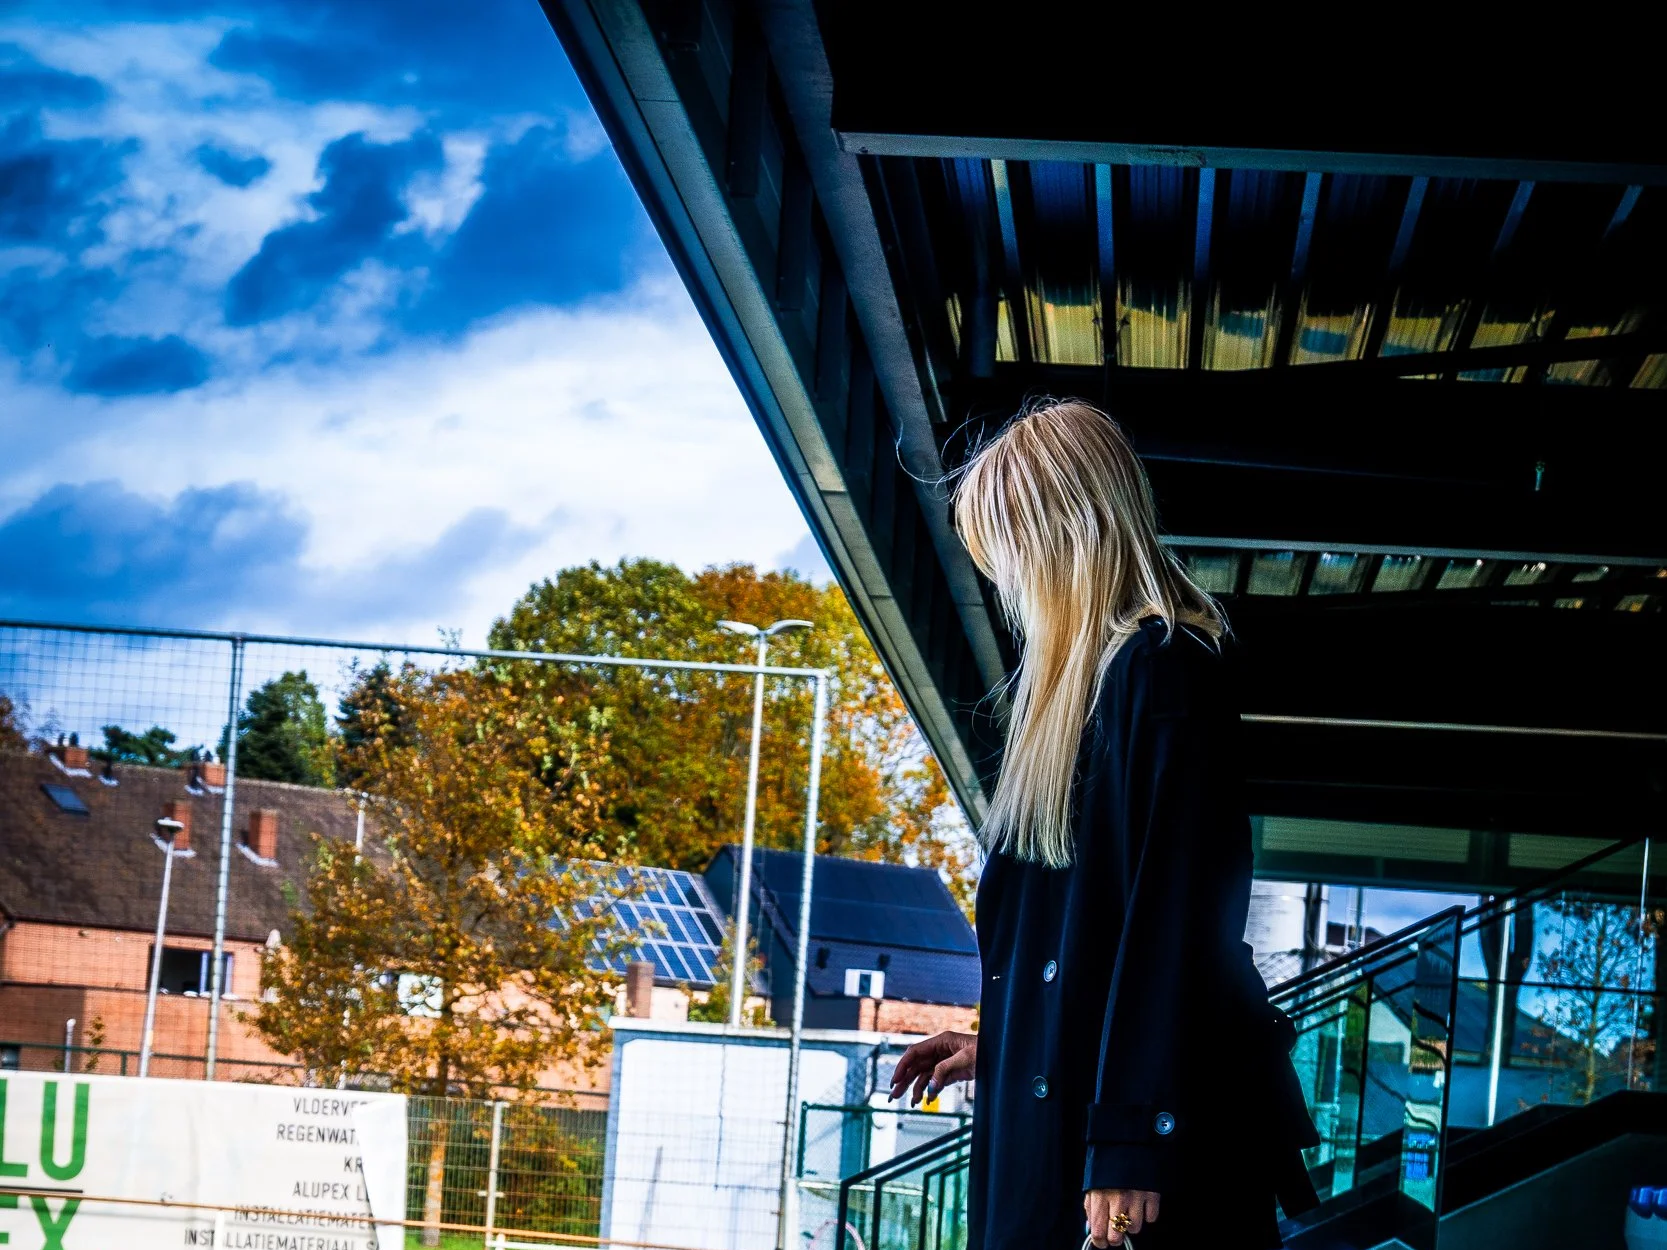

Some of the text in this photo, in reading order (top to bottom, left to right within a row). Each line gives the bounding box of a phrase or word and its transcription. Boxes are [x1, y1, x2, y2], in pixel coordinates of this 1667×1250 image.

[293, 1097, 368, 1116] VLOERV
[276, 1123, 359, 1146] REGENWAT
[292, 1180, 349, 1201] ALUPEX
